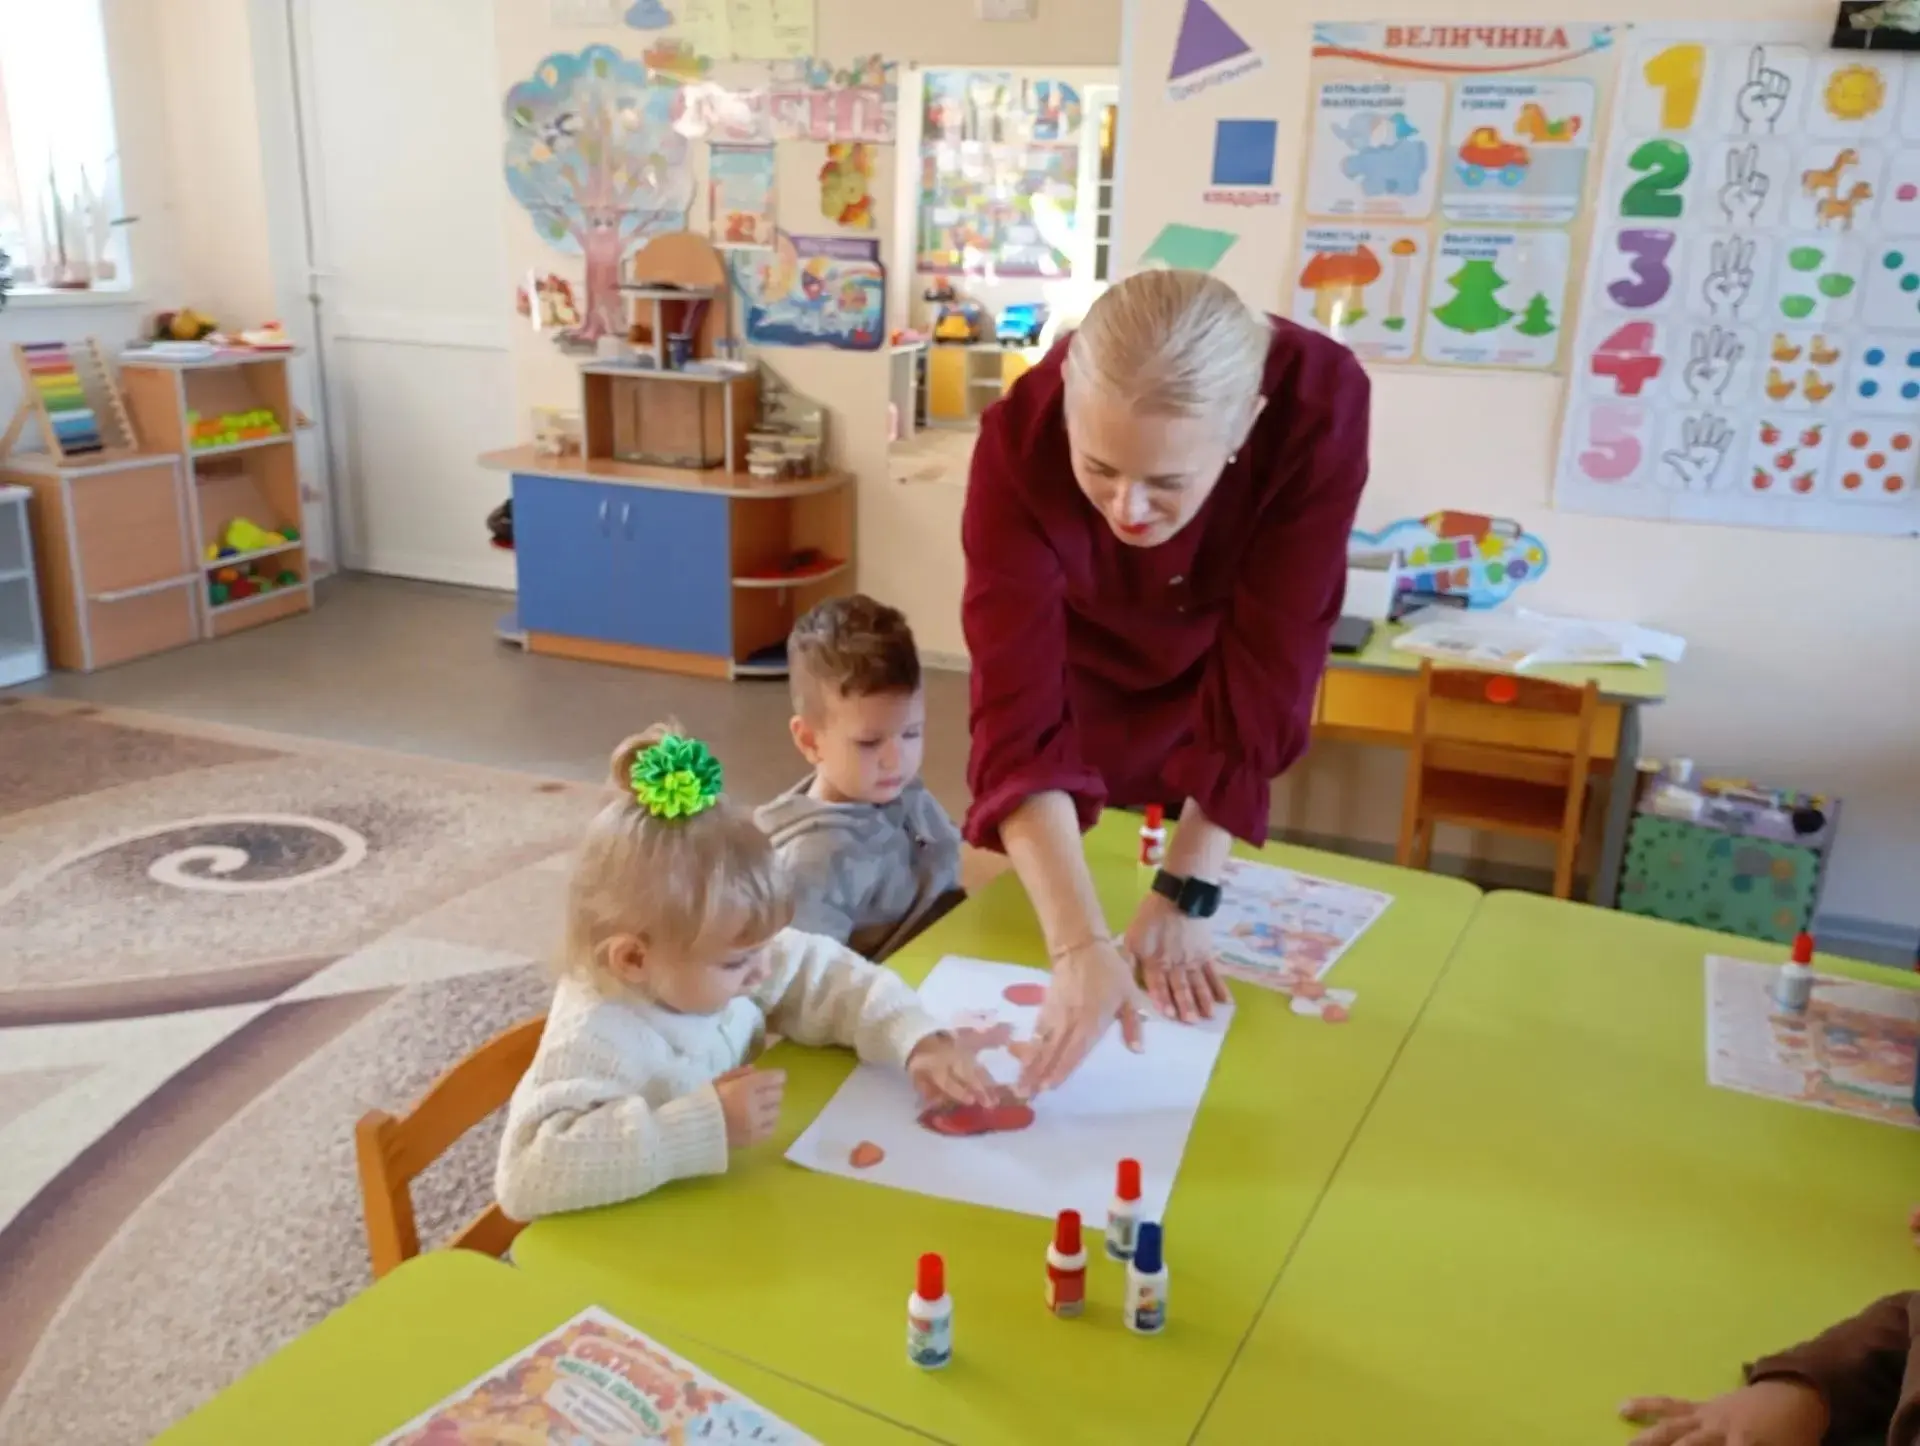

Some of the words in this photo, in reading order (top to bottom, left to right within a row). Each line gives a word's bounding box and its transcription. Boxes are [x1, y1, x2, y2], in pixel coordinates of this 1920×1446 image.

[1385, 26, 1570, 49] ВЕЛИЧИНА
[1642, 42, 1706, 131] 1
[1621, 139, 1691, 217] 2
[1607, 229, 1676, 308] 3
[1590, 321, 1664, 396] 4
[1578, 404, 1645, 483] 5
